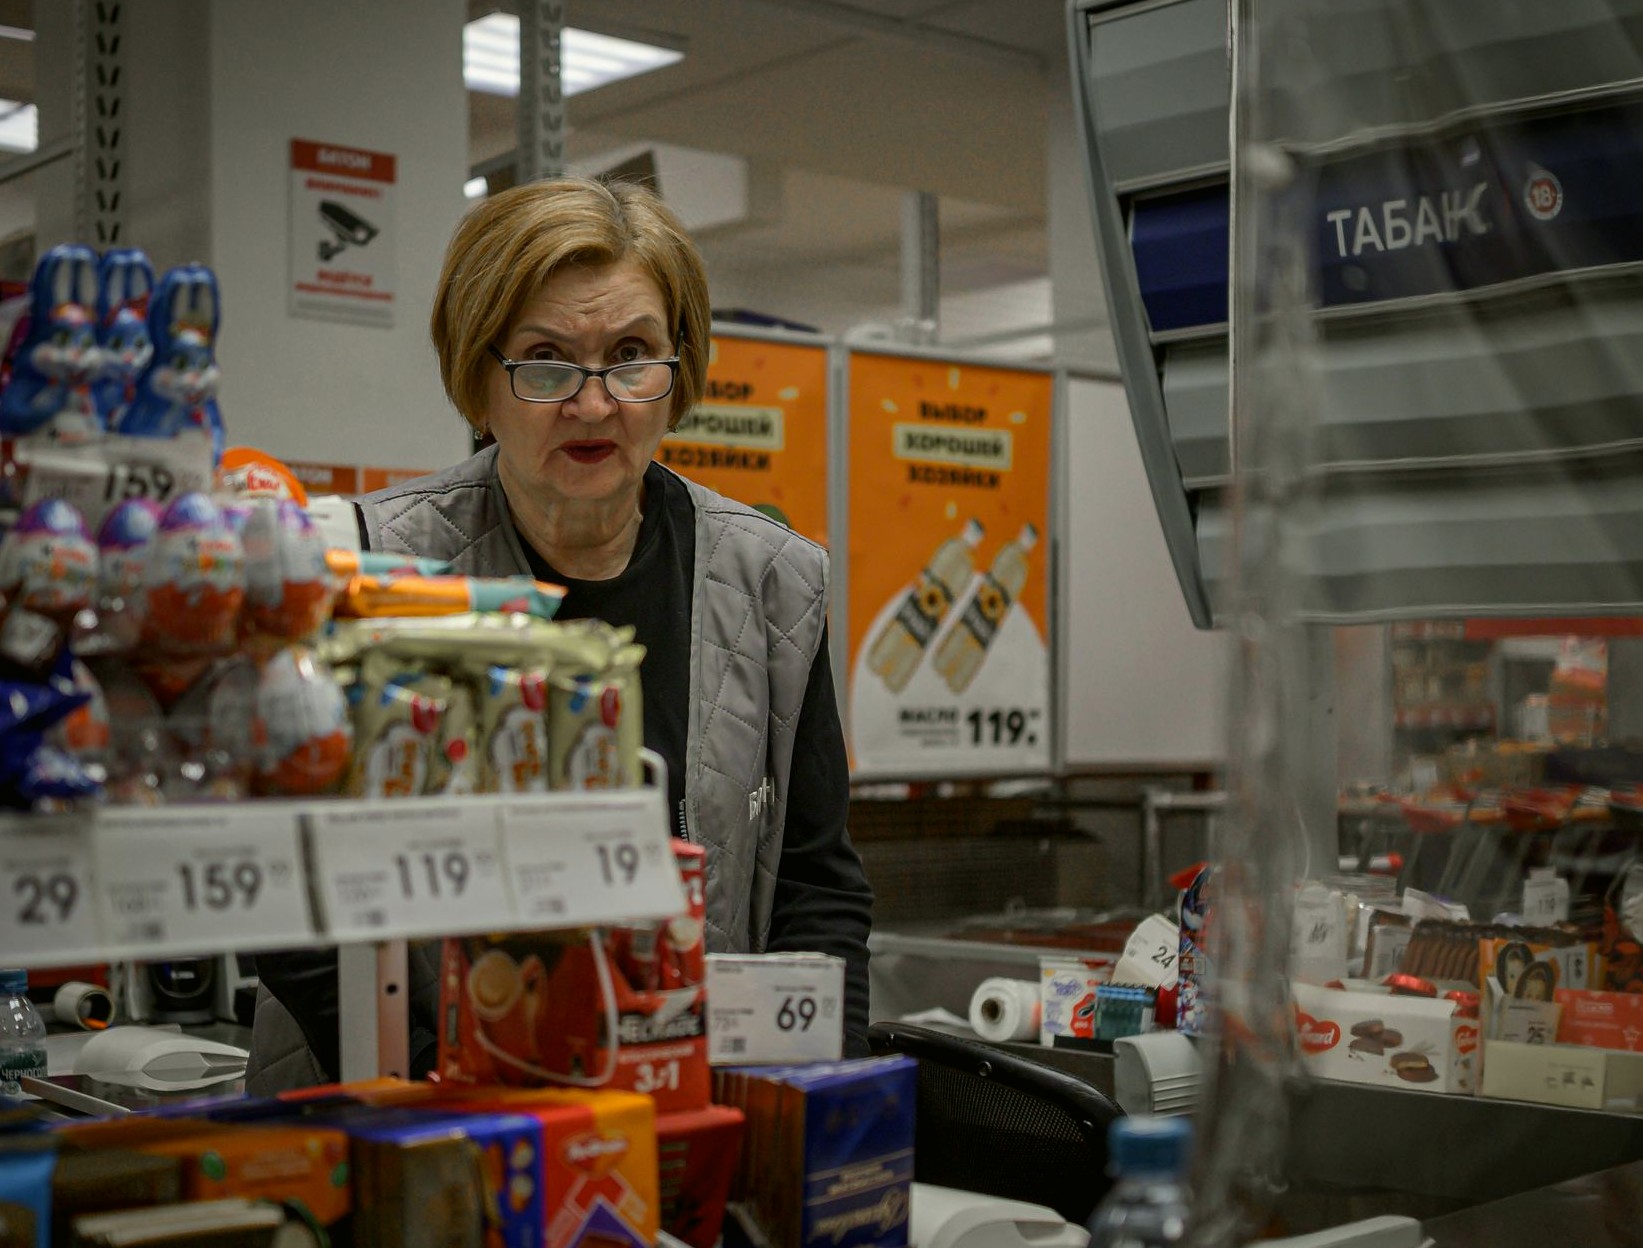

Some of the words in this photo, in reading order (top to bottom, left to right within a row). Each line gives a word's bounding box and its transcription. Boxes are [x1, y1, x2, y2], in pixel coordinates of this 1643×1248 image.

[1326, 182, 1489, 258] ТАБАК
[918, 399, 988, 424] ВЫБОР
[904, 430, 1005, 457] ХОРОШЕЙ
[908, 461, 1001, 489] ХОЗЯЙКИ
[395, 850, 470, 899] 119
[595, 843, 640, 886] 19
[14, 872, 80, 925] 29
[177, 861, 263, 913] 159
[1151, 945, 1177, 970] 24
[776, 995, 817, 1033] 69
